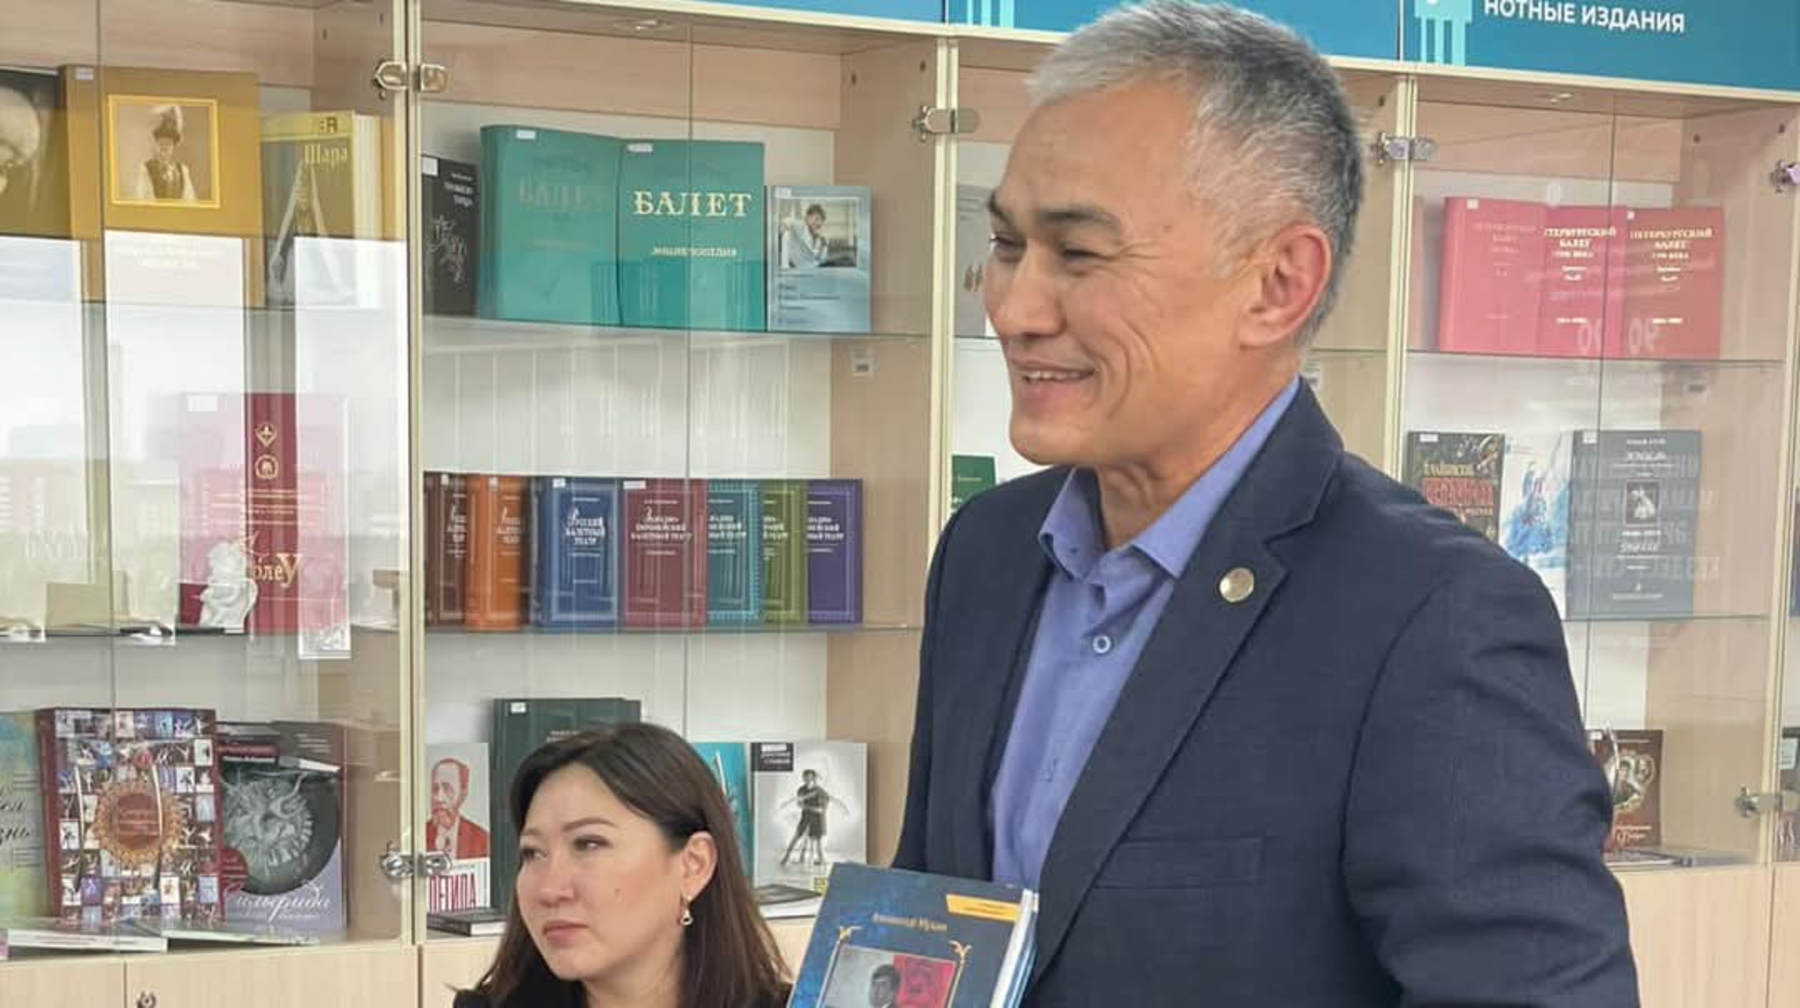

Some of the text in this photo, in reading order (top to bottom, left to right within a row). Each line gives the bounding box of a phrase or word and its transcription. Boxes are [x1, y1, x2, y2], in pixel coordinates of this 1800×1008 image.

[1484, 0, 1686, 33] НОТНЫЕ ИЗДАНИЯ
[632, 190, 752, 218] БАЛЕТ
